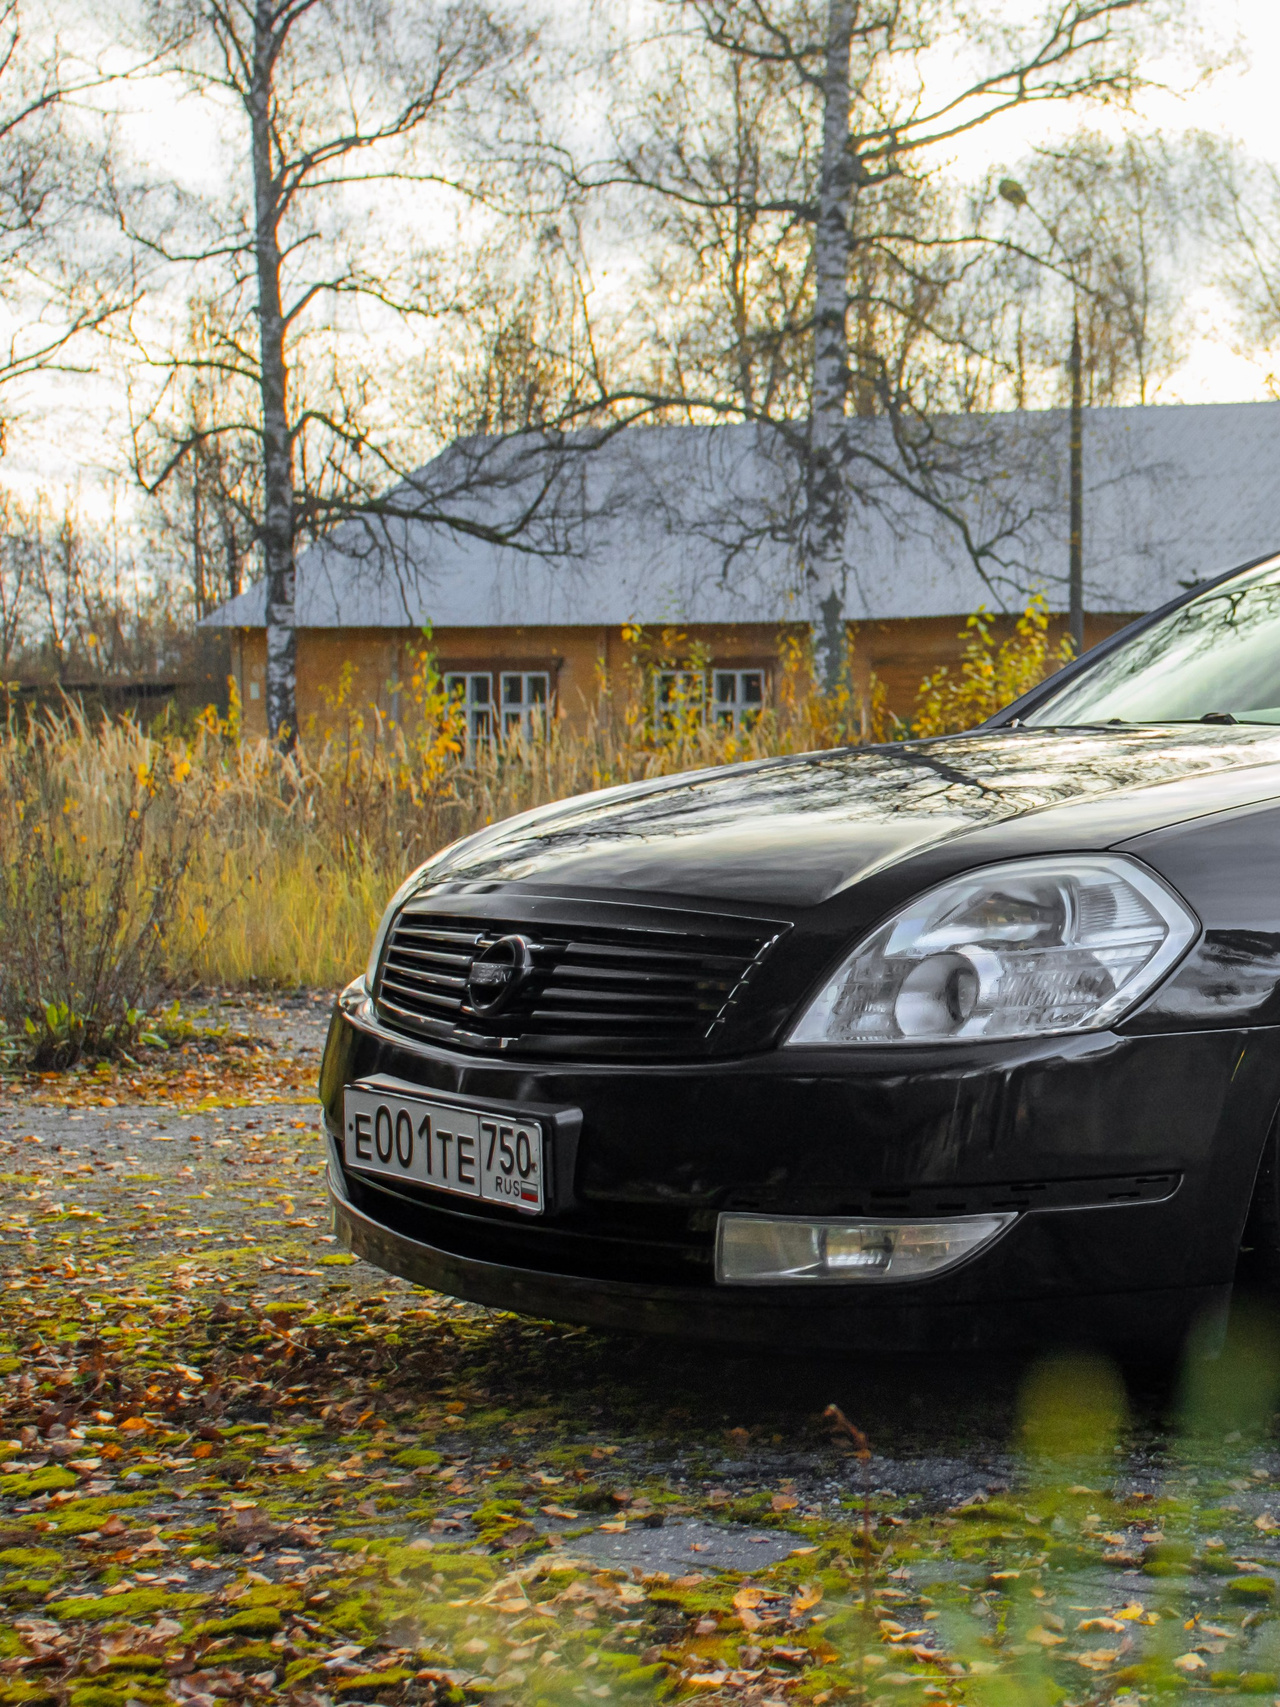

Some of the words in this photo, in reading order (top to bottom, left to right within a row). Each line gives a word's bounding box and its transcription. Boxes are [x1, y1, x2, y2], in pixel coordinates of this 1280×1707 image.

[354, 1103, 476, 1186] E001TE
[482, 1121, 532, 1179] 750
[495, 1175, 520, 1197] RUS
